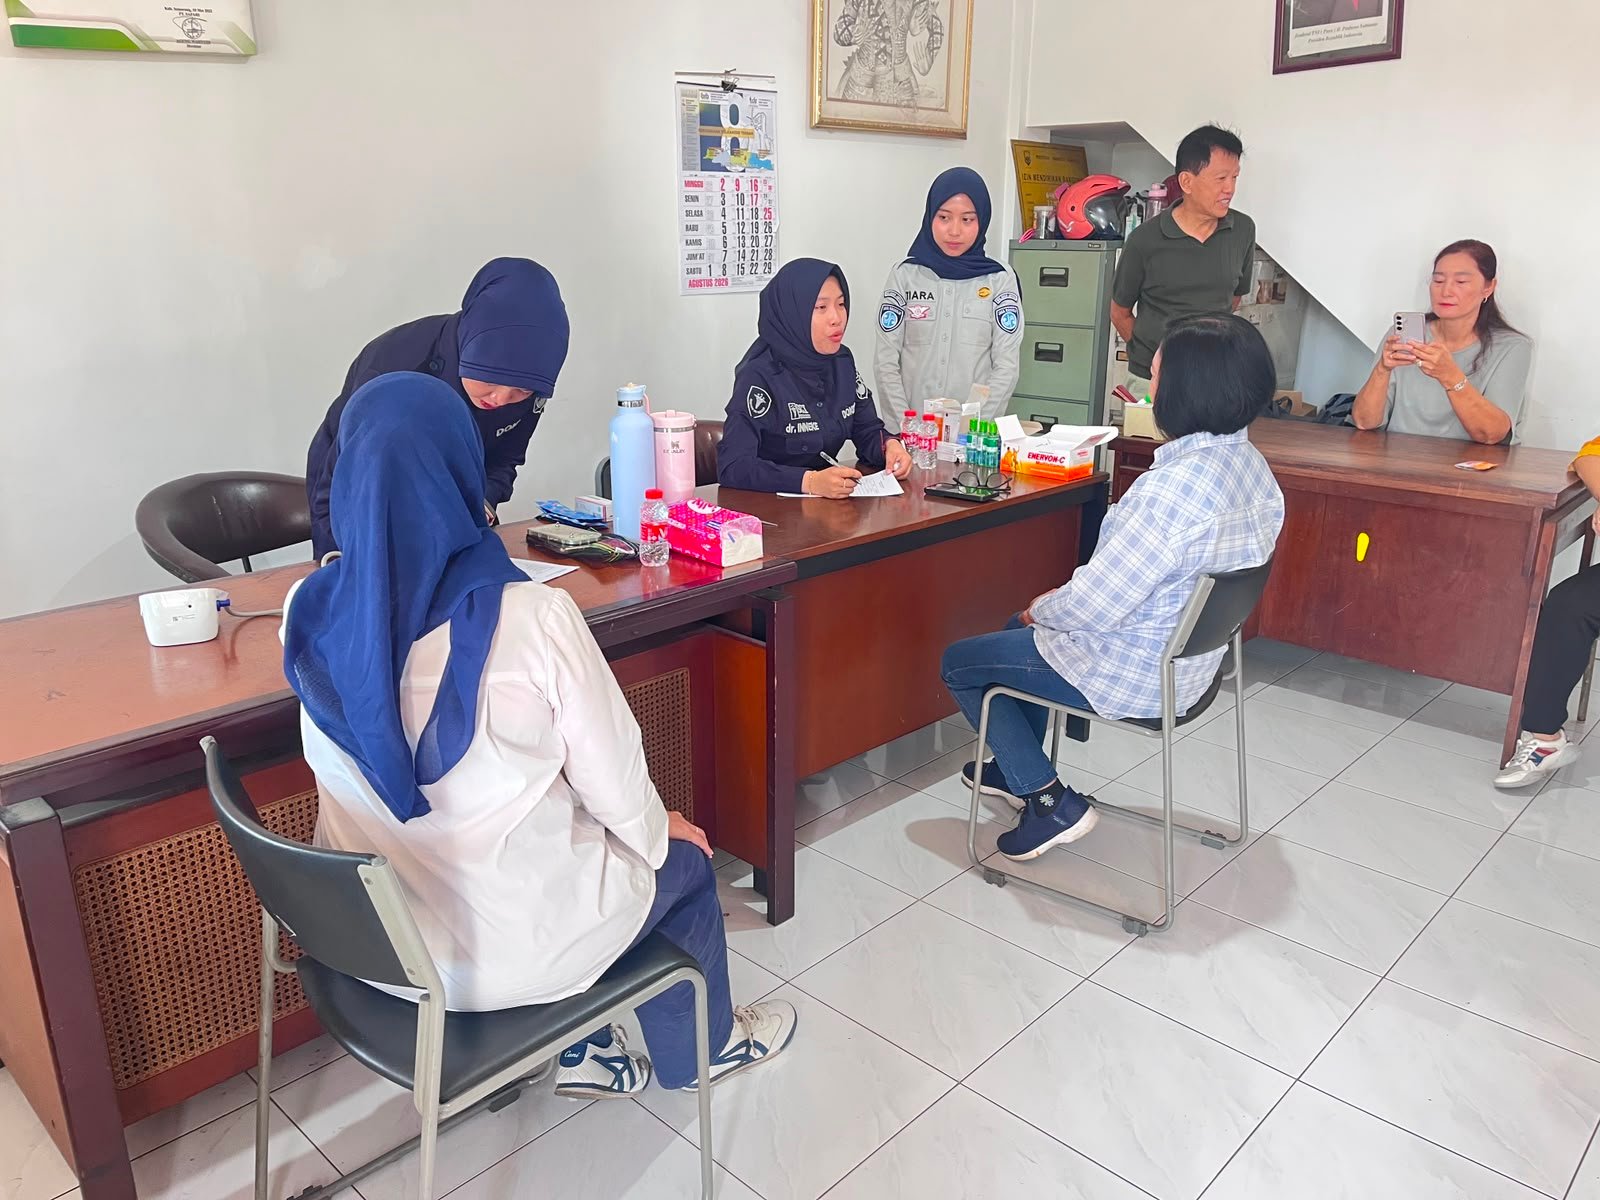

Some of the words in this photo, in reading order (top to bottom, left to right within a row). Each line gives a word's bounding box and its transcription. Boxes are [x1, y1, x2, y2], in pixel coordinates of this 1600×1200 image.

[720, 178, 725, 191] 2
[735, 178, 740, 191] 9
[750, 179, 758, 192] 16
[721, 193, 726, 206] 3
[736, 193, 745, 206] 10
[750, 194, 758, 206] 17
[721, 207, 726, 220] 4
[736, 208, 744, 220] 11
[750, 207, 759, 220] 18
[763, 208, 772, 220] 25
[722, 222, 726, 234] 5
[737, 222, 745, 234] 12
[751, 221, 759, 234] 19
[764, 221, 772, 234] 26
[723, 236, 727, 248] 6
[738, 236, 746, 248] 13
[751, 235, 759, 248] 20
[765, 235, 773, 247] 27
[723, 250, 727, 262] 7
[737, 250, 746, 262] 14
[751, 249, 759, 261] 21
[764, 248, 772, 261] 28
[708, 264, 712, 276] 1
[722, 264, 727, 276] 8
[737, 263, 745, 276] 15
[750, 263, 758, 275] 22
[763, 262, 772, 274] 29
[688, 279, 713, 288] AGUSTUS
[786, 423, 796, 433] dr.
[797, 422, 820, 433] INNEKE
[1027, 452, 1066, 464] ENERVON-C
